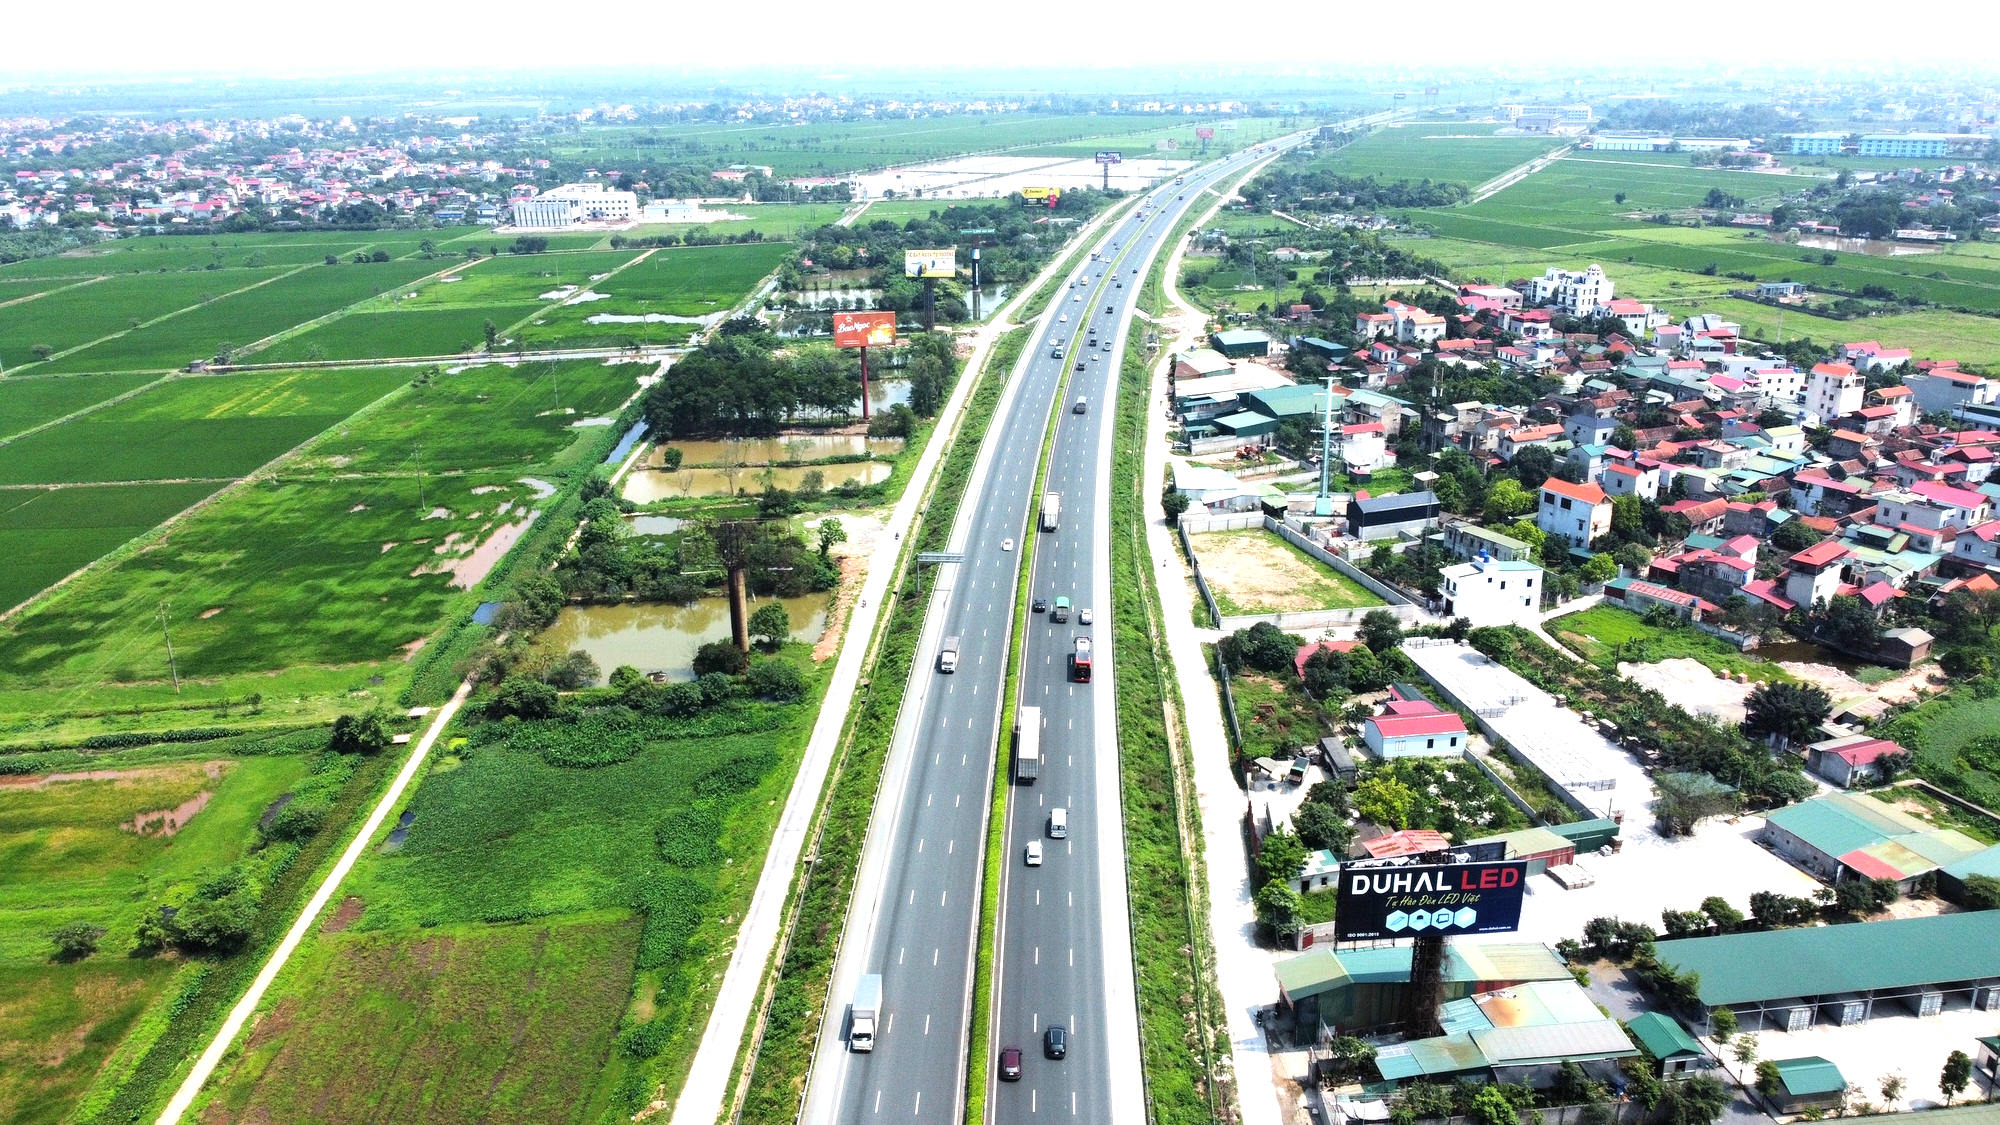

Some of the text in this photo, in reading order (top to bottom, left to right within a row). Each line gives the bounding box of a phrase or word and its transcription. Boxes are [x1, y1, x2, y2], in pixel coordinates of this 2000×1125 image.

[1352, 867, 1519, 895] DUHAL LED
[1399, 894, 1417, 907] Hào
[1418, 894, 1436, 906] Đèn
[1437, 892, 1460, 905] LED
[1461, 892, 1481, 904] Việt
